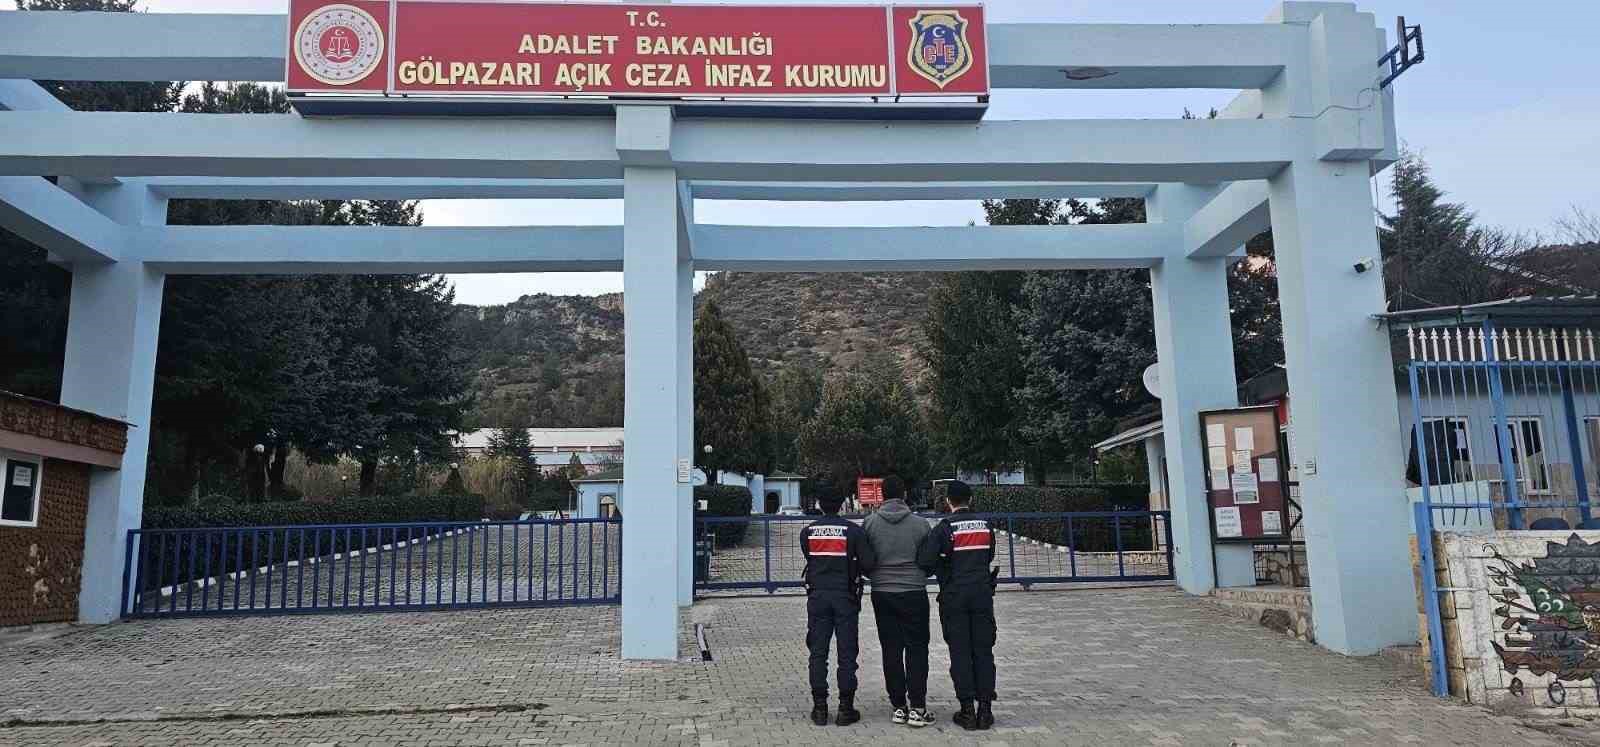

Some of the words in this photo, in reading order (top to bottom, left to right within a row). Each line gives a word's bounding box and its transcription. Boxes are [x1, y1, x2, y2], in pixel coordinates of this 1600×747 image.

[625, 10, 667, 27] T.C.
[518, 34, 619, 55] ADALET
[636, 31, 773, 56] BAKANLIĞI
[398, 57, 541, 86] GÖLPAZARI
[554, 62, 612, 91] AÇIK
[625, 63, 692, 87] CEZA
[705, 58, 773, 87] İNFAZ
[785, 64, 886, 88] KURUMU
